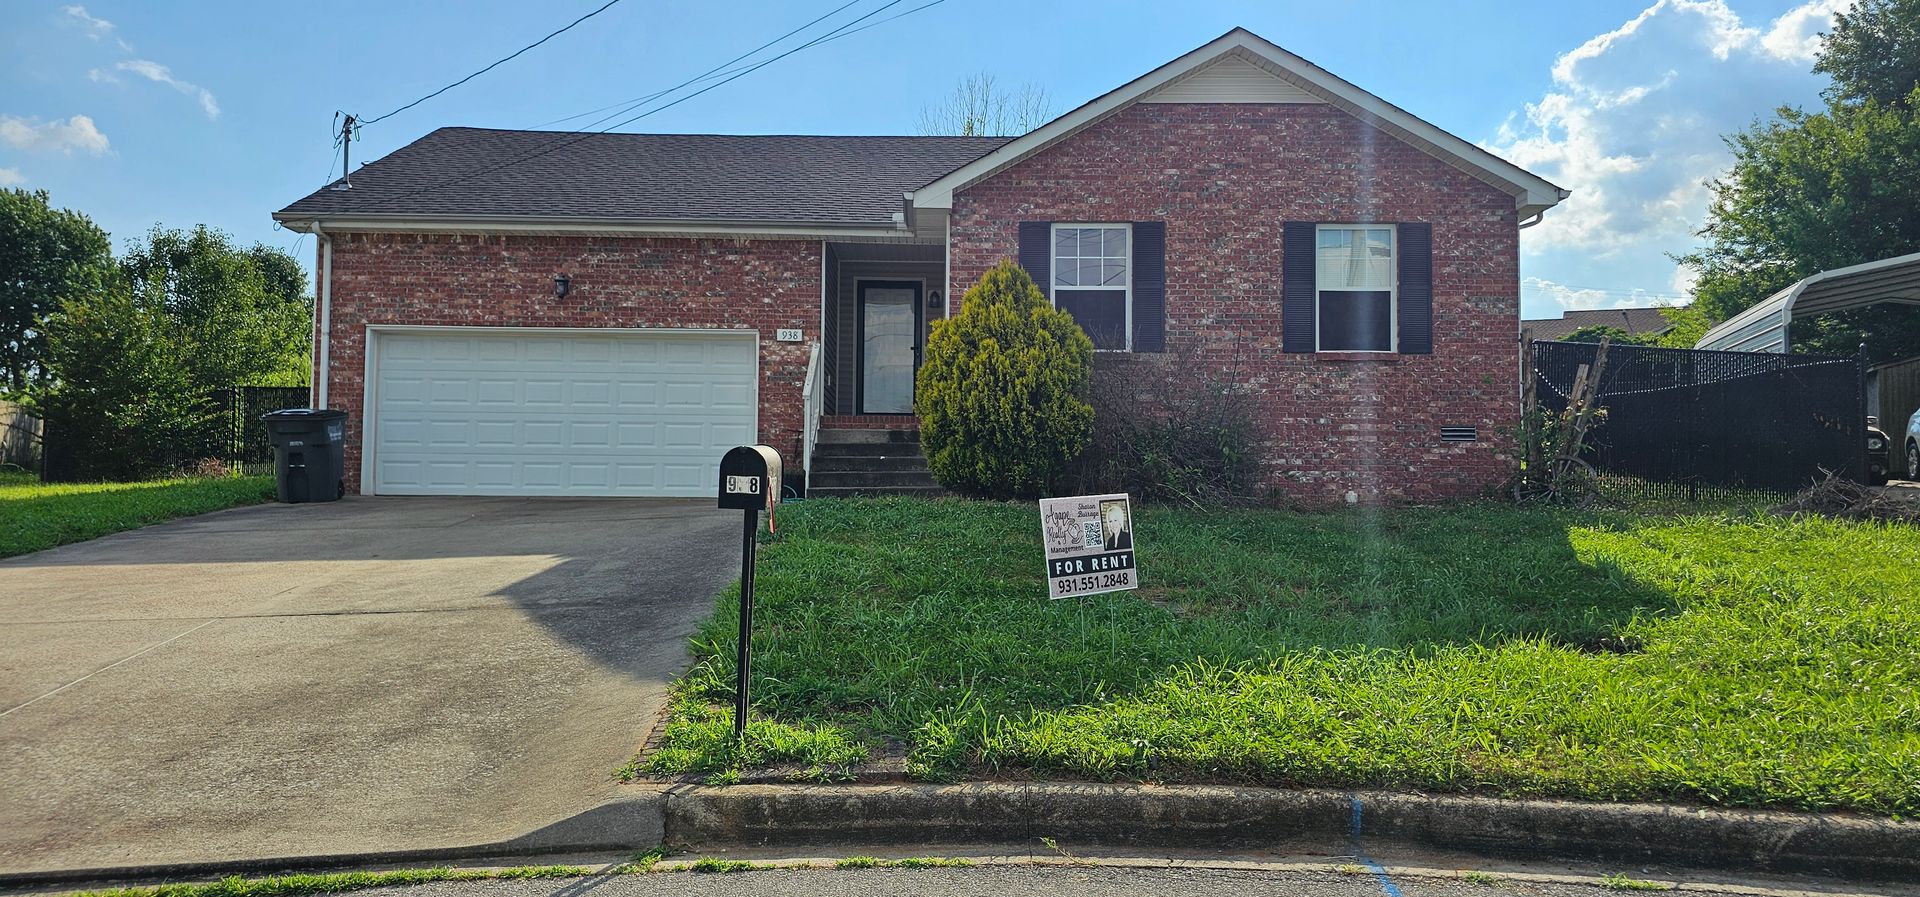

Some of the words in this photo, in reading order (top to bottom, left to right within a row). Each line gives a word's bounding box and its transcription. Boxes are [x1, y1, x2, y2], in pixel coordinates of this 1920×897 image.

[782, 330, 798, 340] 938
[728, 476, 758, 493] 98
[1050, 545, 1085, 554] Management
[1055, 560, 1084, 575] FOR
[1091, 555, 1128, 571] RENT
[1058, 572, 1129, 594] 931.551.2848
